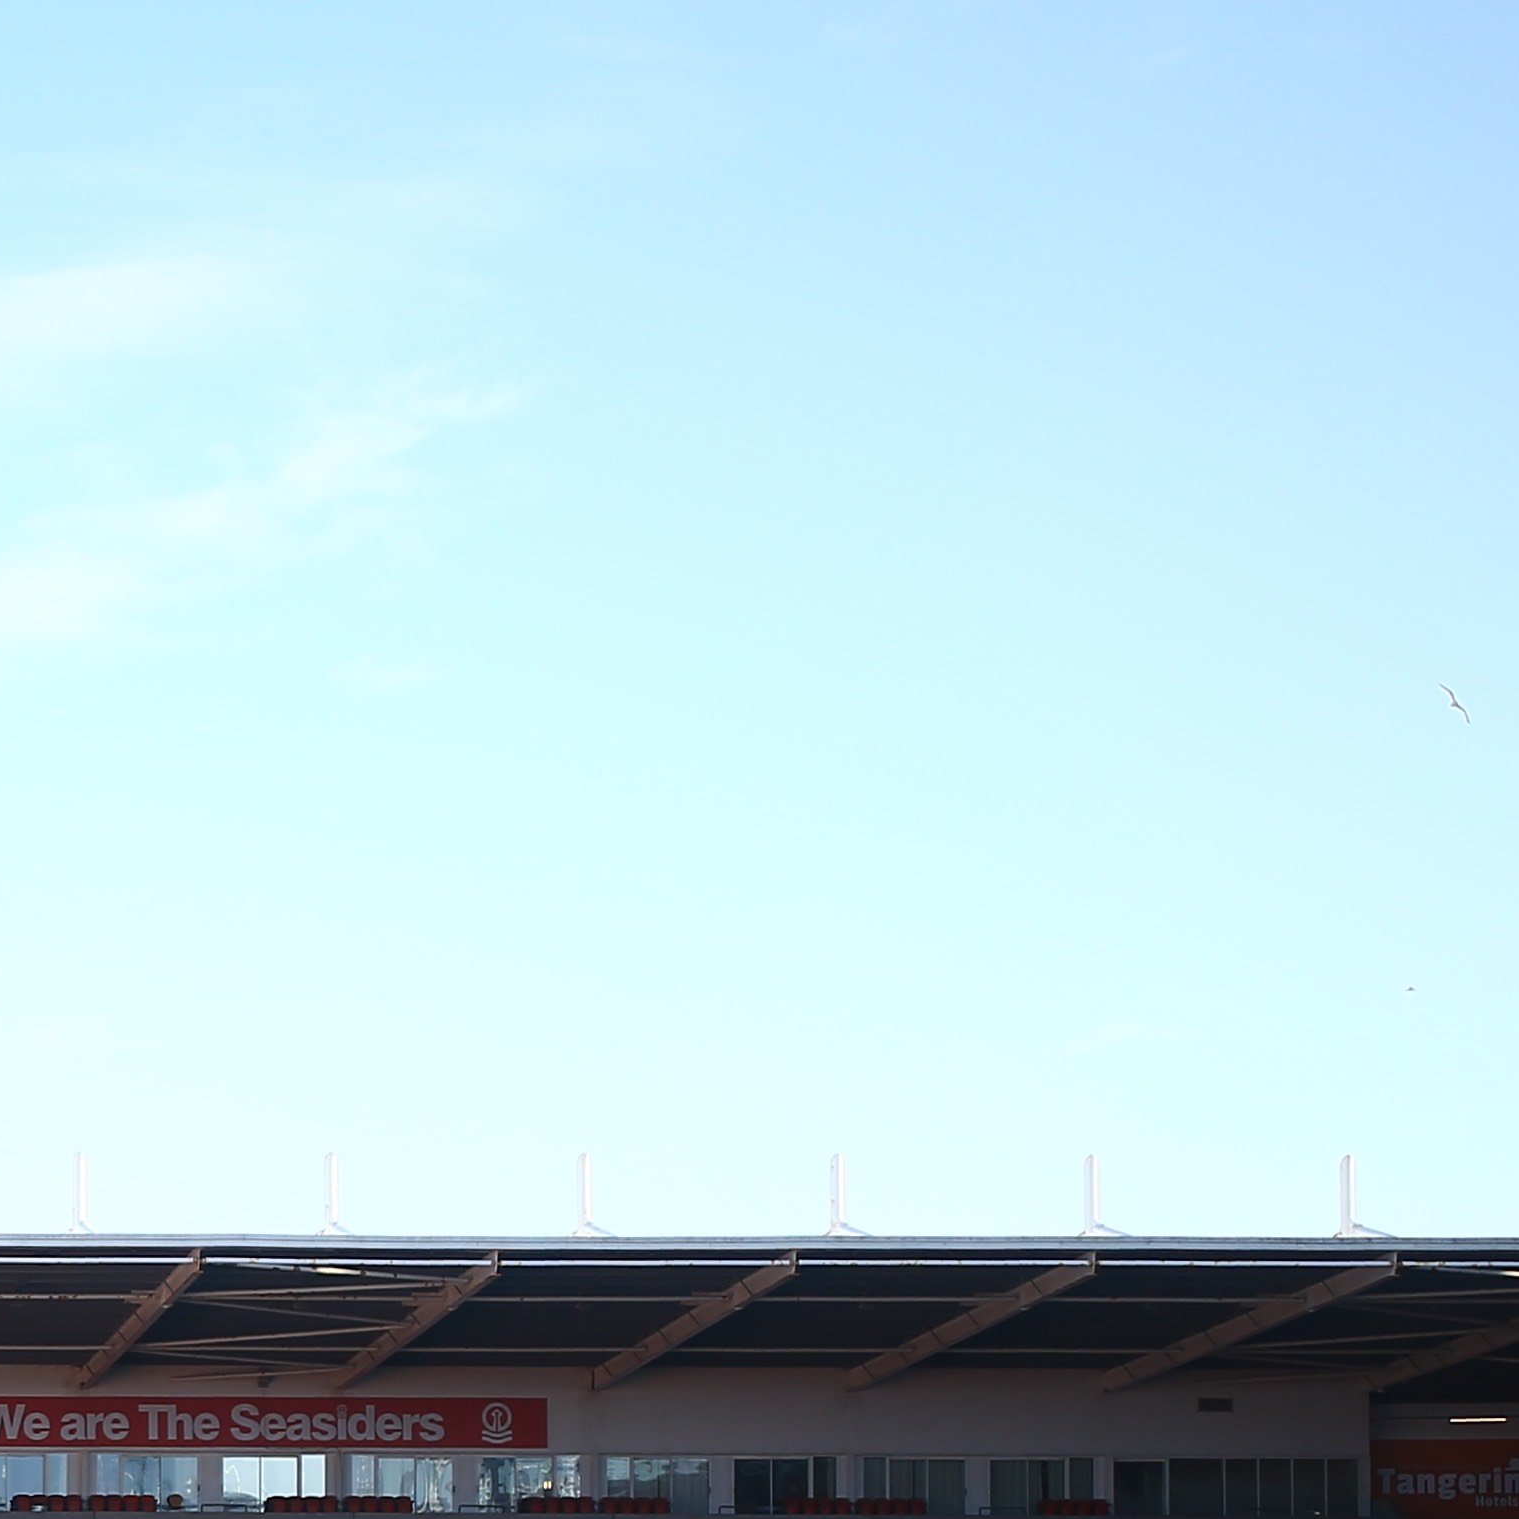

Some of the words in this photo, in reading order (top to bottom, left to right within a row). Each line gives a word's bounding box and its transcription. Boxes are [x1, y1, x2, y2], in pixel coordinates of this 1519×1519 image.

[60, 1410, 129, 1441] are
[139, 1403, 220, 1440] The
[230, 1403, 444, 1442] Seasiders
